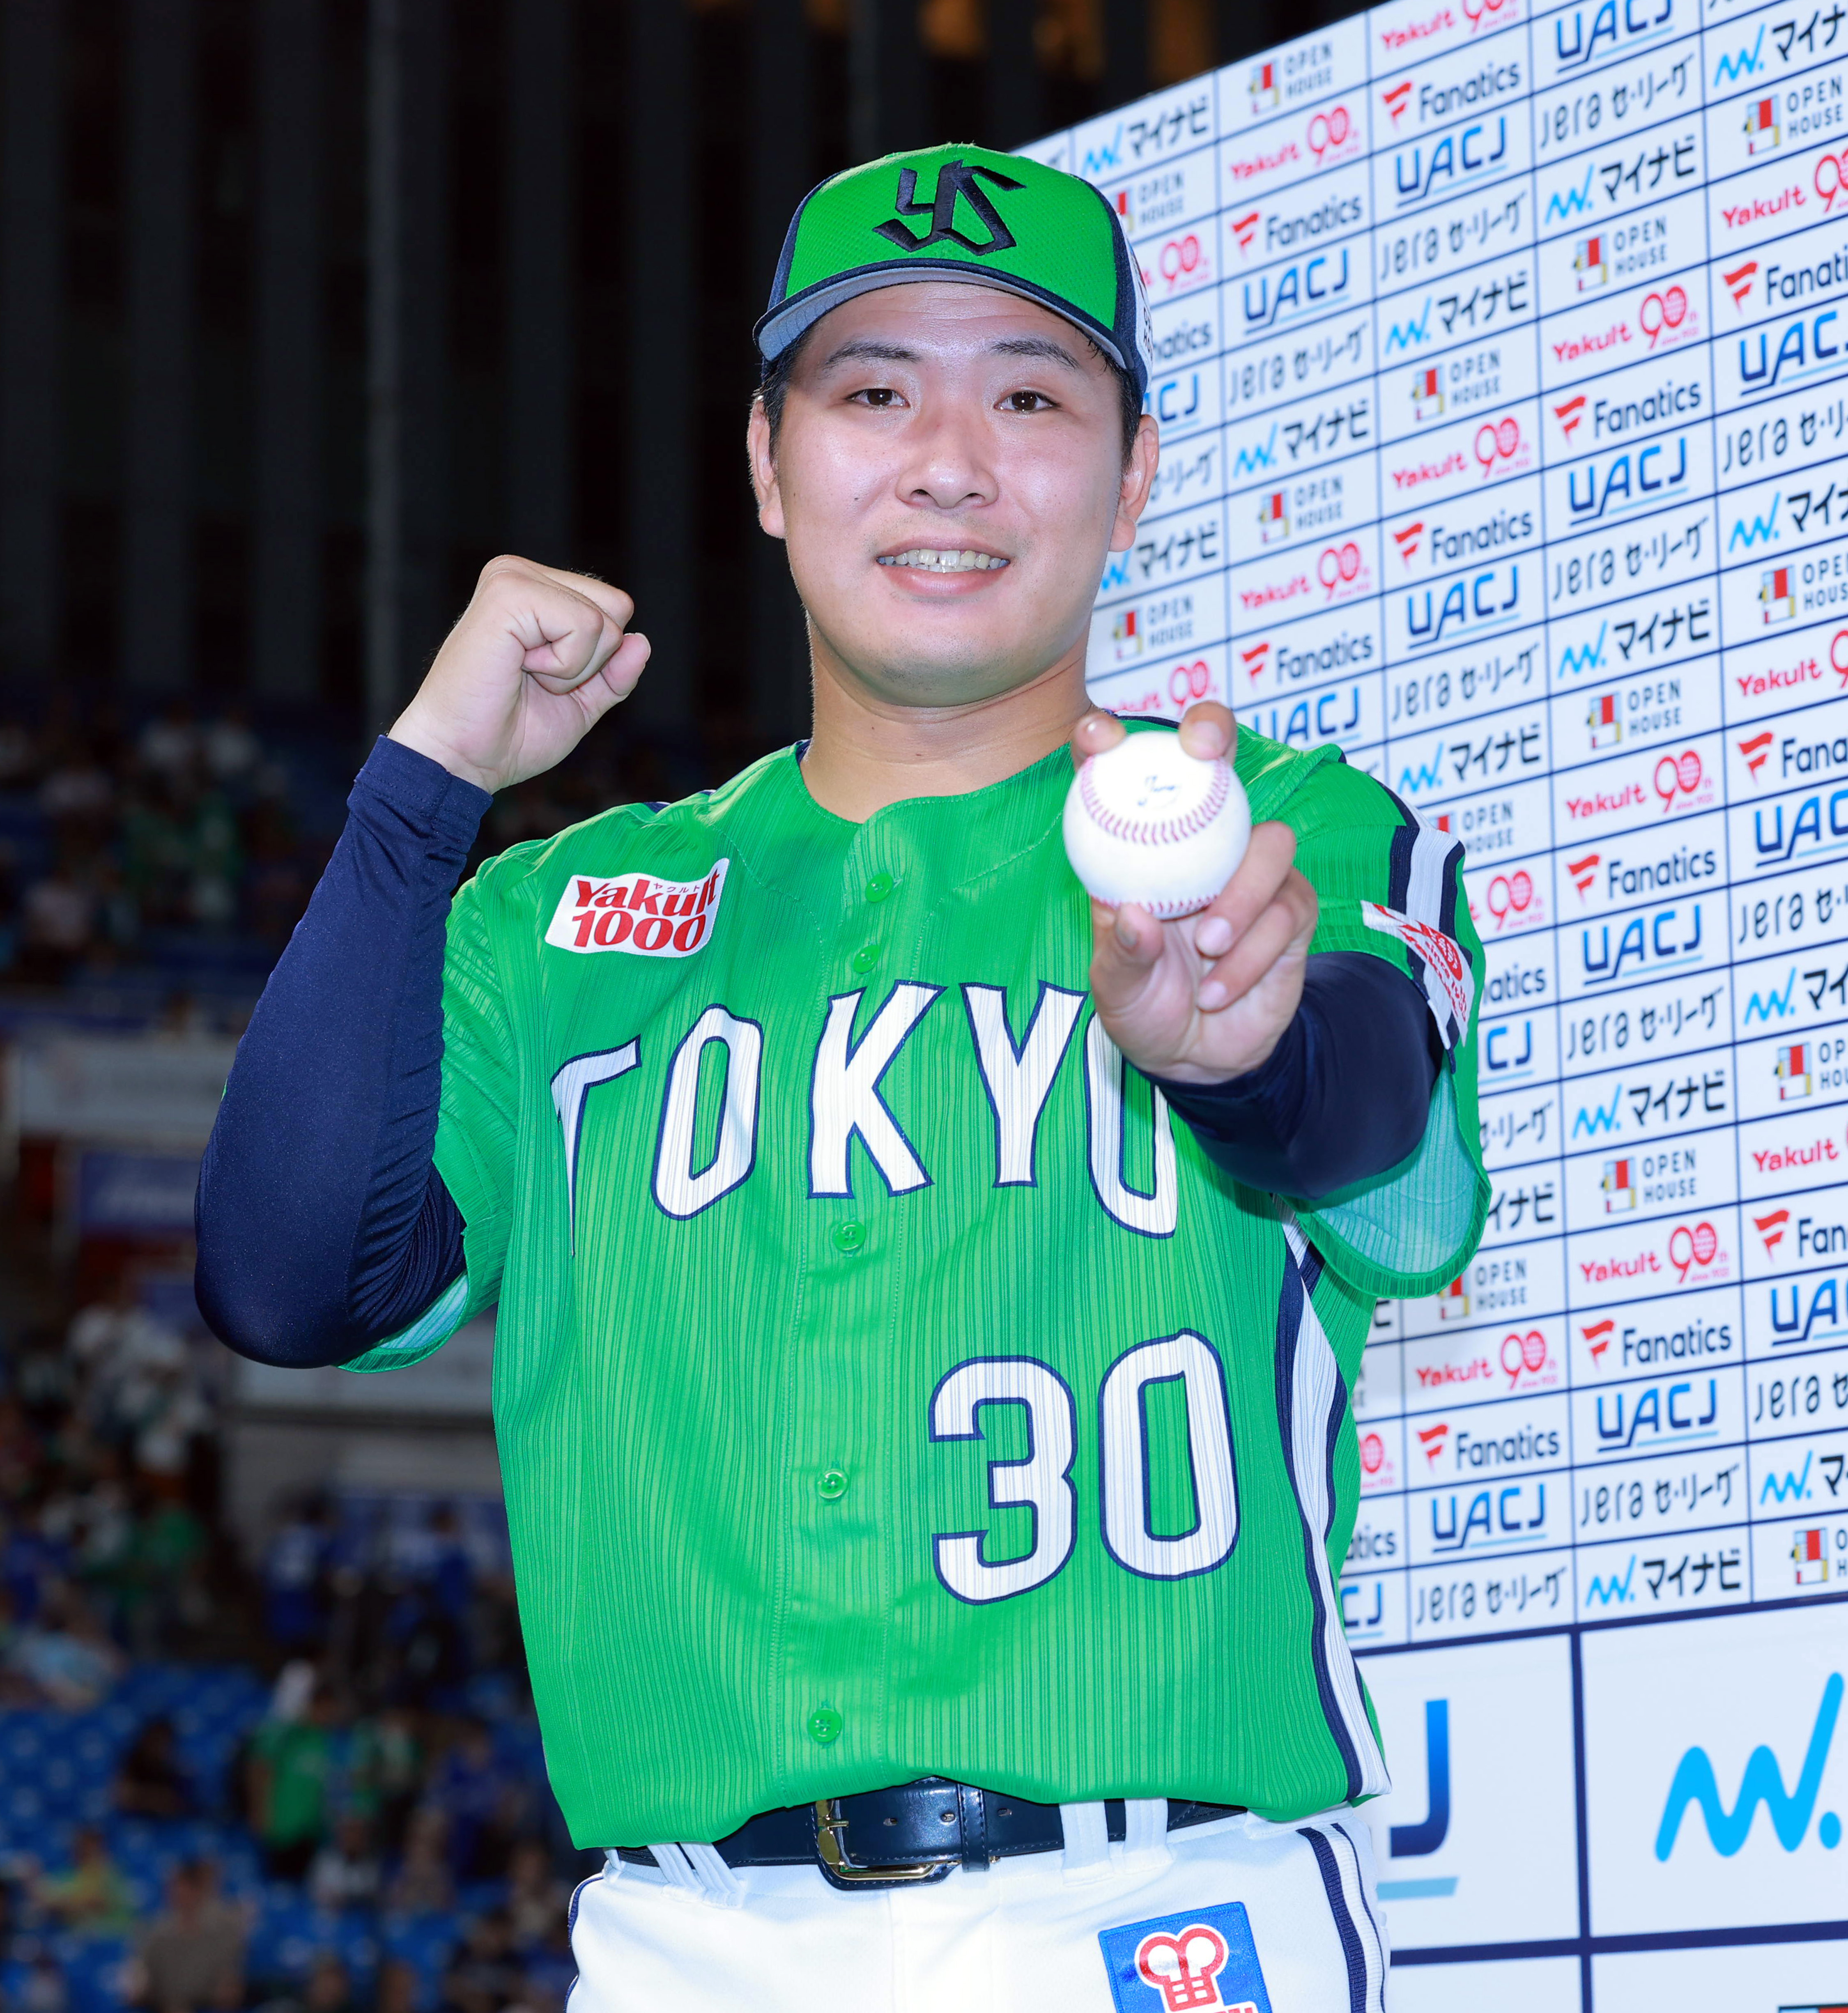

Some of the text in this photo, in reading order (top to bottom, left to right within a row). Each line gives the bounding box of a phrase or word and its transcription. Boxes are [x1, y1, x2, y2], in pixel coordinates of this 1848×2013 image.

[1381, 10, 1455, 49] Yakult
[1420, 63, 1520, 121] Fanatics
[1787, 76, 1841, 113] OPEN
[1128, 97, 1208, 157] マイナビ
[1231, 143, 1300, 179] Yakult
[1308, 106, 1349, 164] 90
[1788, 104, 1842, 137] HOUSE
[1396, 117, 1506, 208] UACJ
[1600, 136, 1695, 201] マイナビ
[1266, 196, 1362, 250] Fanatics
[1722, 186, 1806, 228] Yakult
[1161, 234, 1200, 288] 90
[1614, 218, 1666, 252] OPEN
[1616, 244, 1666, 275] HOUSE
[1244, 249, 1348, 335] UACJ
[1437, 271, 1528, 333] マイナビ
[1553, 323, 1632, 362] Yakult
[1640, 285, 1687, 349] 90
[1450, 351, 1500, 383] OPEN
[1740, 310, 1848, 396] UAC
[1451, 376, 1500, 405] HOUSE
[1595, 381, 1701, 438] Fanatics
[1283, 400, 1368, 458] マイナビ
[1393, 417, 1519, 488] Yakult 90
[1569, 437, 1686, 526] UACJ
[1431, 510, 1533, 563] Fanatics
[1240, 542, 1360, 608] Yakult 90
[1803, 553, 1848, 585] OPE
[1407, 565, 1518, 650] UACJ
[1614, 600, 1710, 660] マイナビ
[1277, 633, 1373, 682] Fanatics
[1737, 658, 1822, 696] Yakult
[1628, 680, 1680, 711] OPEN
[1629, 707, 1681, 735] HOUSE
[1449, 724, 1540, 781] マイナビ
[1566, 784, 1646, 818] Yakult
[1654, 750, 1702, 813] 90
[1463, 802, 1512, 831] OPEN
[575, 869, 720, 917] Yakult
[653, 882, 700, 894] ヤクルト
[1609, 847, 1716, 898] Fanatics
[1487, 870, 1533, 930] 90
[572, 910, 706, 952] 1000
[1583, 904, 1701, 986] UACJ
[550, 979, 1179, 1257] TOKYO
[1628, 1071, 1725, 1126] マイナビ
[1643, 1150, 1695, 1178] OPEN
[1752, 1138, 1839, 1172] Yakult
[1644, 1177, 1696, 1202] HOUSE
[1475, 1260, 1526, 1287] OPEN
[1580, 1252, 1661, 1282] Yakult
[1669, 1222, 1717, 1284] 90
[1476, 1287, 1526, 1311] HOUSE
[1415, 1360, 1492, 1387] Yakult
[1501, 1330, 1546, 1389] 90
[1623, 1319, 1731, 1366] Fanatics
[1597, 1379, 1717, 1453] UACJ
[928, 1327, 1241, 1606] 30
[1457, 1425, 1560, 1469] Fanatics
[1432, 1484, 1545, 1553] UACJ
[1643, 1549, 1741, 1599] マイナビ
